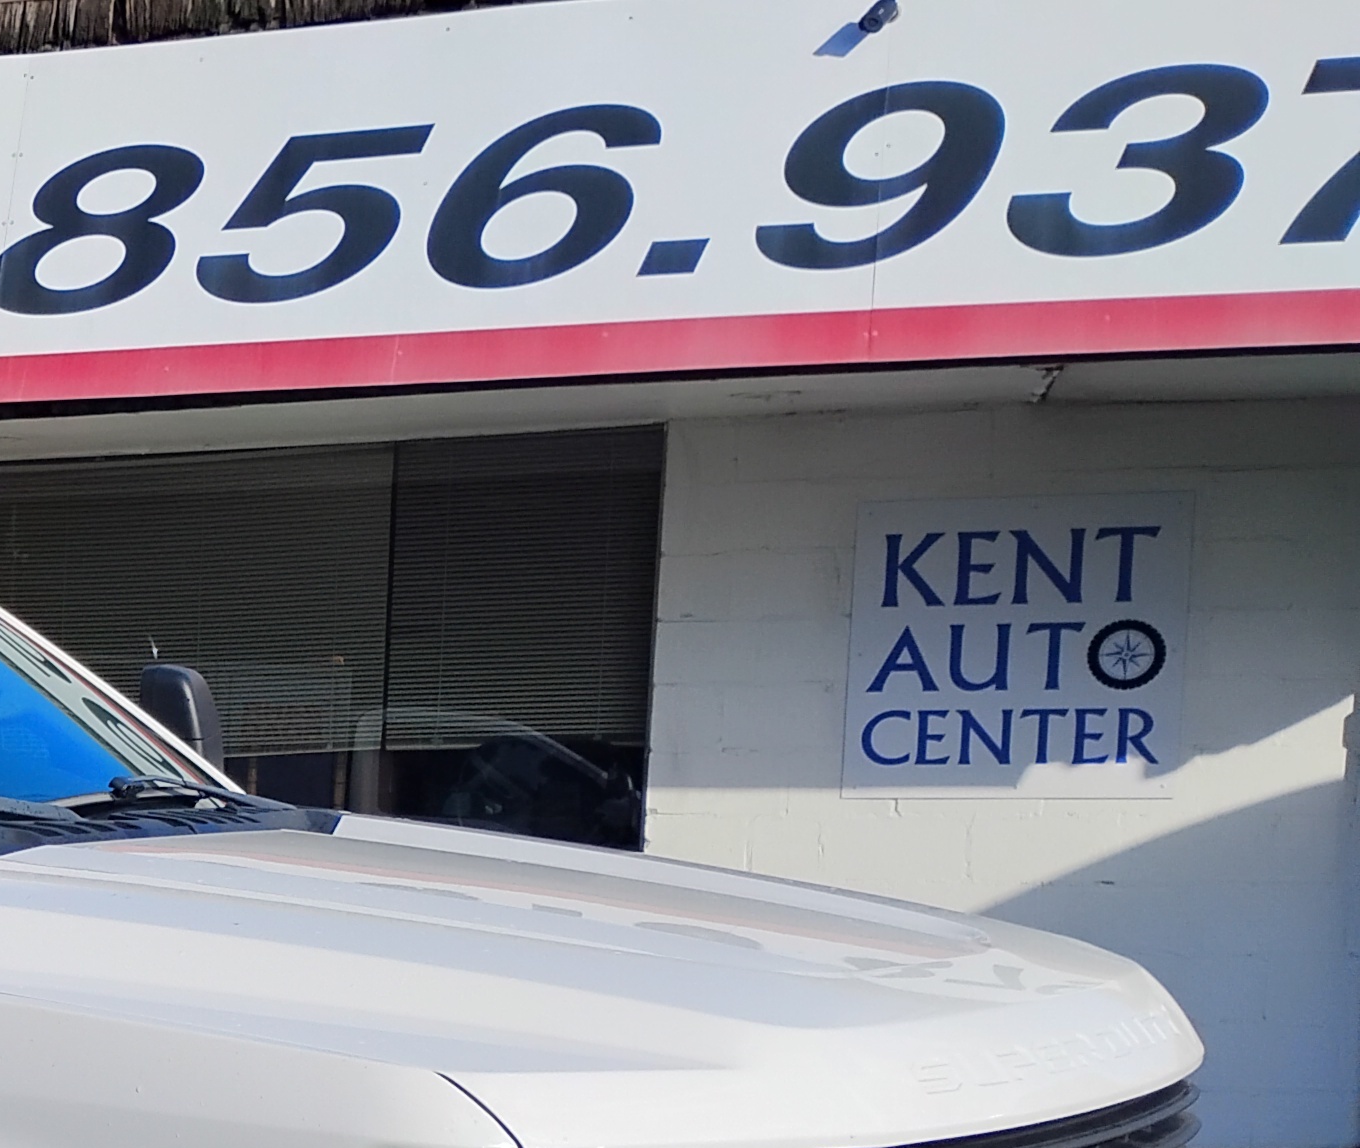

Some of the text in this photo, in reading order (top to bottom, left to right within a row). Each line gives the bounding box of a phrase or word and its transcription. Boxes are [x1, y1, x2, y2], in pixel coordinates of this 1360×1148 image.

[880, 525, 1162, 608] KENT
[865, 618, 1168, 693] AUTO
[860, 707, 1160, 767] CENTER
